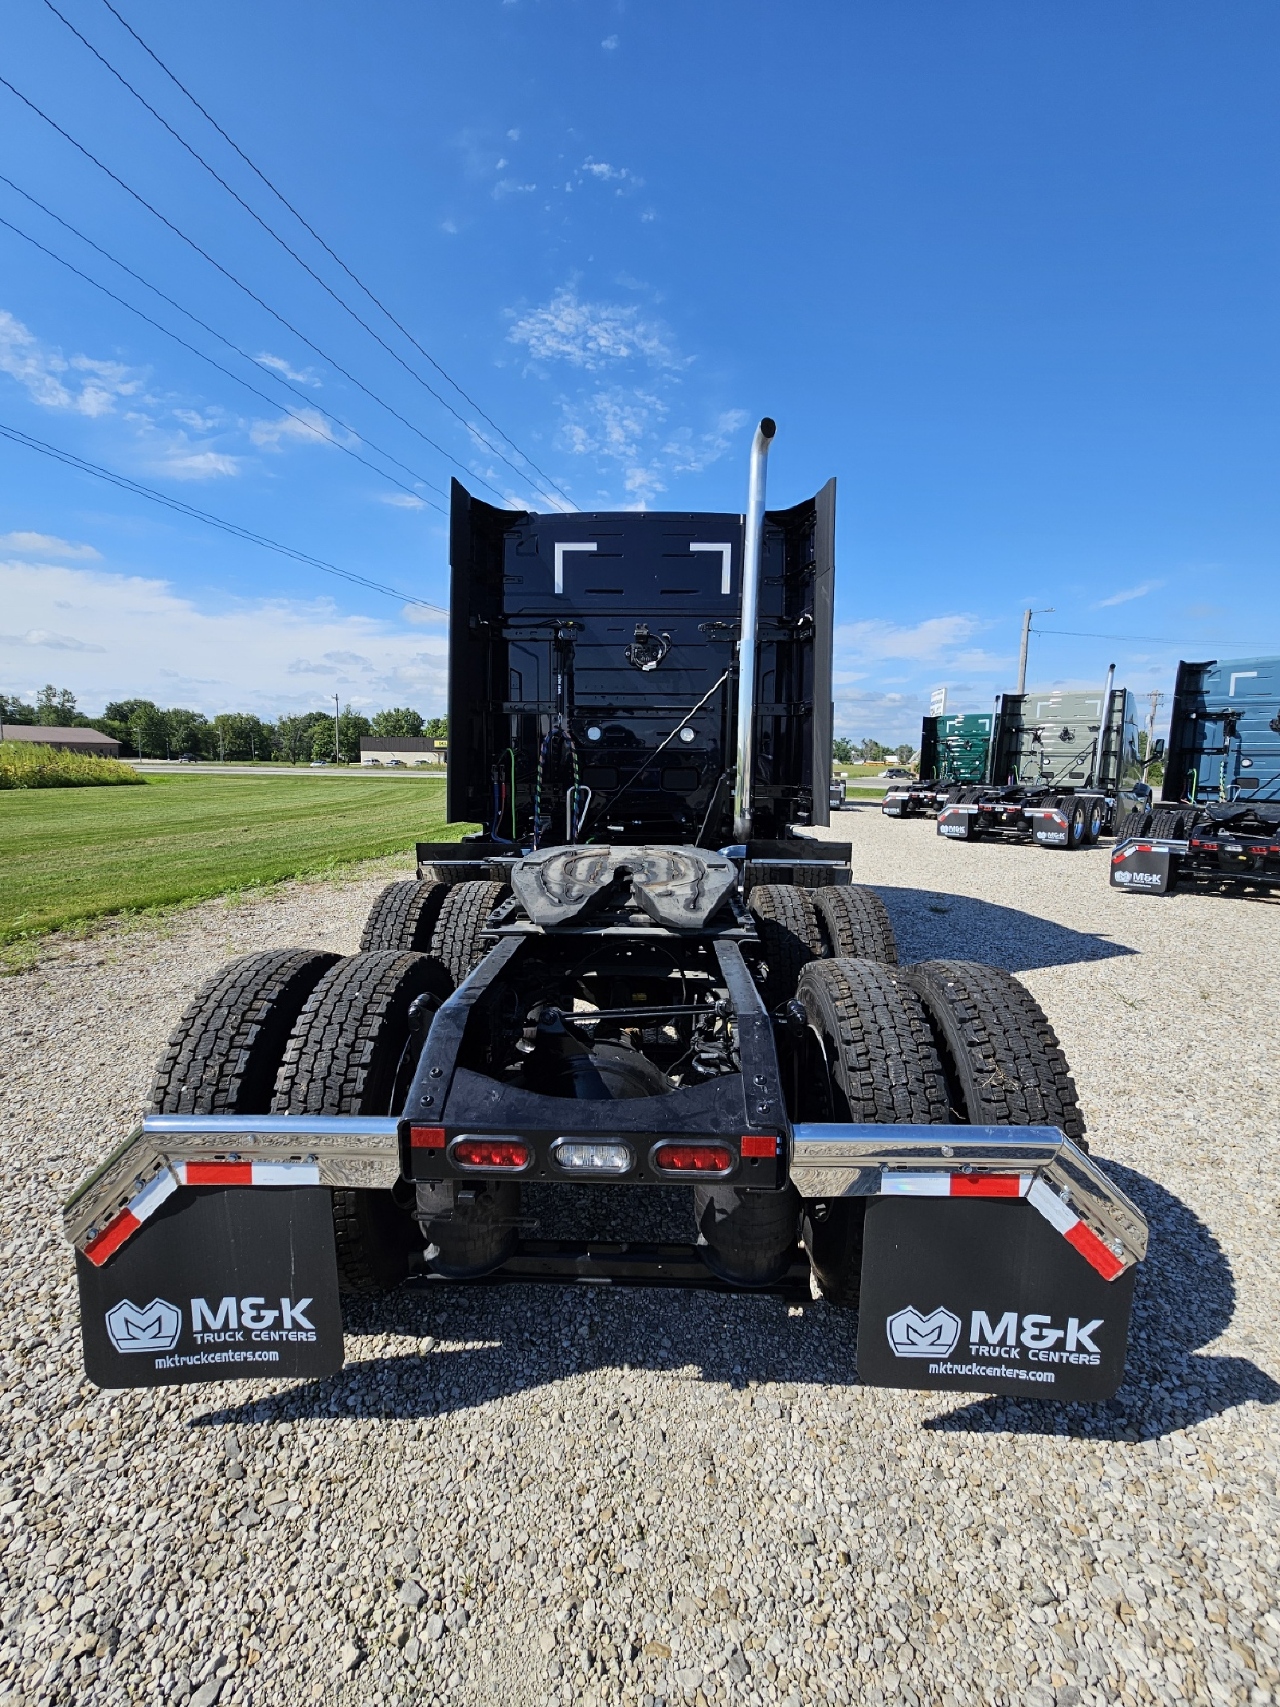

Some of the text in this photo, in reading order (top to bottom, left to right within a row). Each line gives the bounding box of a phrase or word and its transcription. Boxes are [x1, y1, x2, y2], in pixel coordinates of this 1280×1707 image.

[1132, 872, 1162, 882] M&K
[190, 1296, 315, 1332] M&K
[193, 1331, 317, 1345] TRUCK CENTERS
[969, 1310, 1105, 1353] M&K
[154, 1350, 279, 1369] mktruckcenters.com
[969, 1344, 1101, 1365] TRUCK CENTERS
[928, 1362, 1055, 1383] mktruckcenters.com
